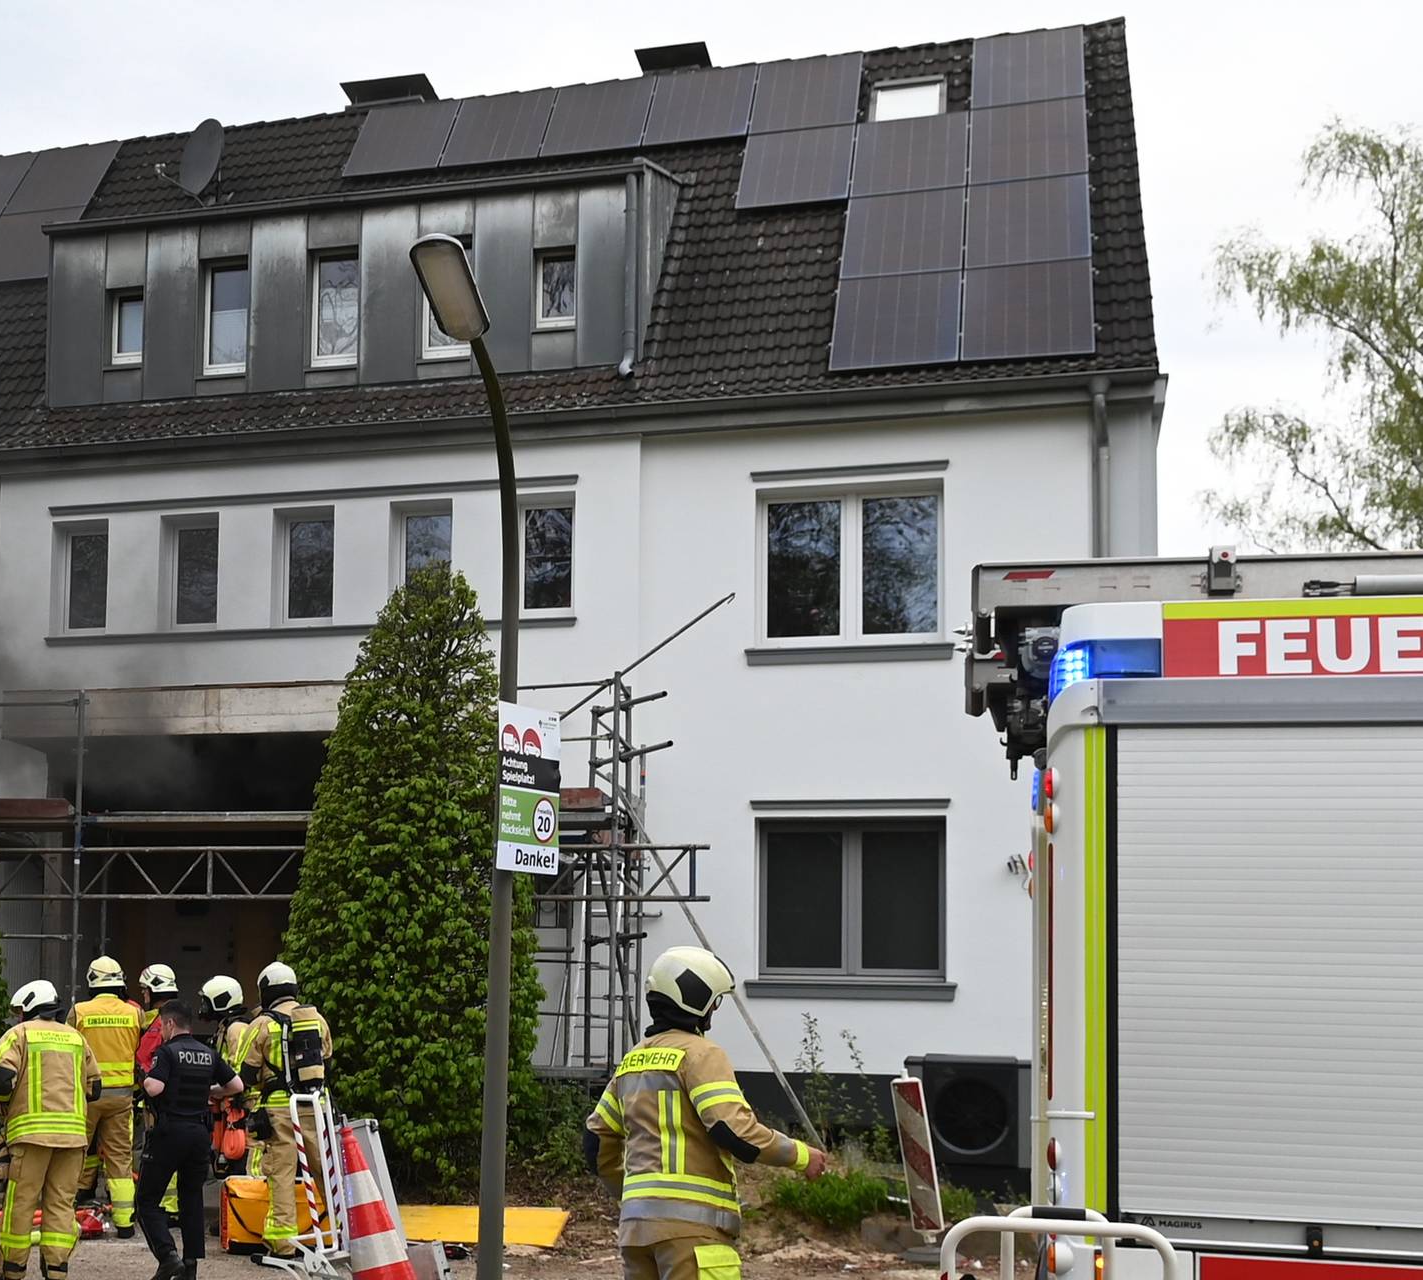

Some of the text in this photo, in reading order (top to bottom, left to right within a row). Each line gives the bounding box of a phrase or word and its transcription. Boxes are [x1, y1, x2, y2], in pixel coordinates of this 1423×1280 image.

[1218, 617, 1423, 675] FEUE
[502, 756, 528, 772] Achtung
[502, 770, 535, 784] Spielplatz!
[502, 796, 517, 807] Bitte
[537, 816, 551, 833] 20
[515, 849, 555, 868] Danke!
[179, 1051, 212, 1065] POLIZEI
[1159, 1220, 1202, 1229] MAGIRUS
